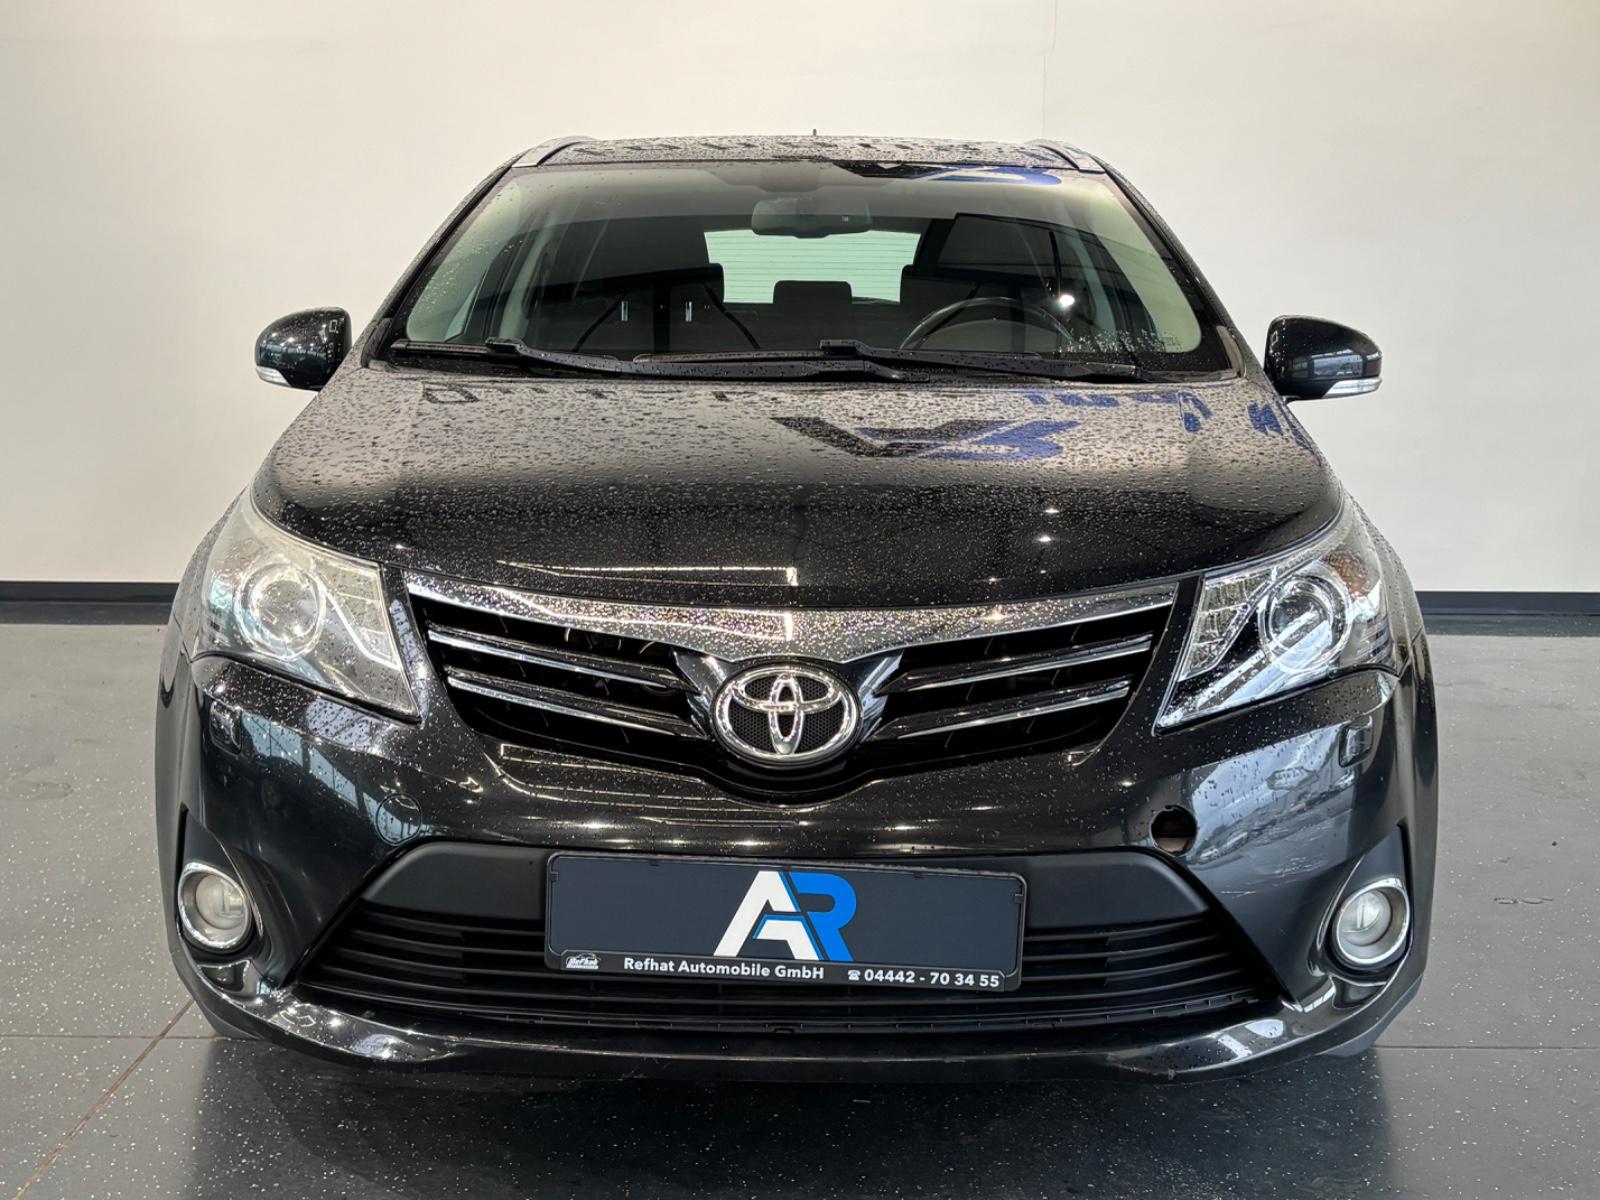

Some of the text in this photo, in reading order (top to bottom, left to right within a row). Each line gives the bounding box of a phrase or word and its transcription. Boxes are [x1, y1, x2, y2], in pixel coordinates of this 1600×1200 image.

[713, 870, 857, 962] AR
[623, 957, 825, 980] Refhat Automobile GmbH
[863, 968, 916, 984] 04442
[929, 971, 951, 986] 70
[953, 972, 975, 987] 34
[979, 974, 1000, 988] 55
